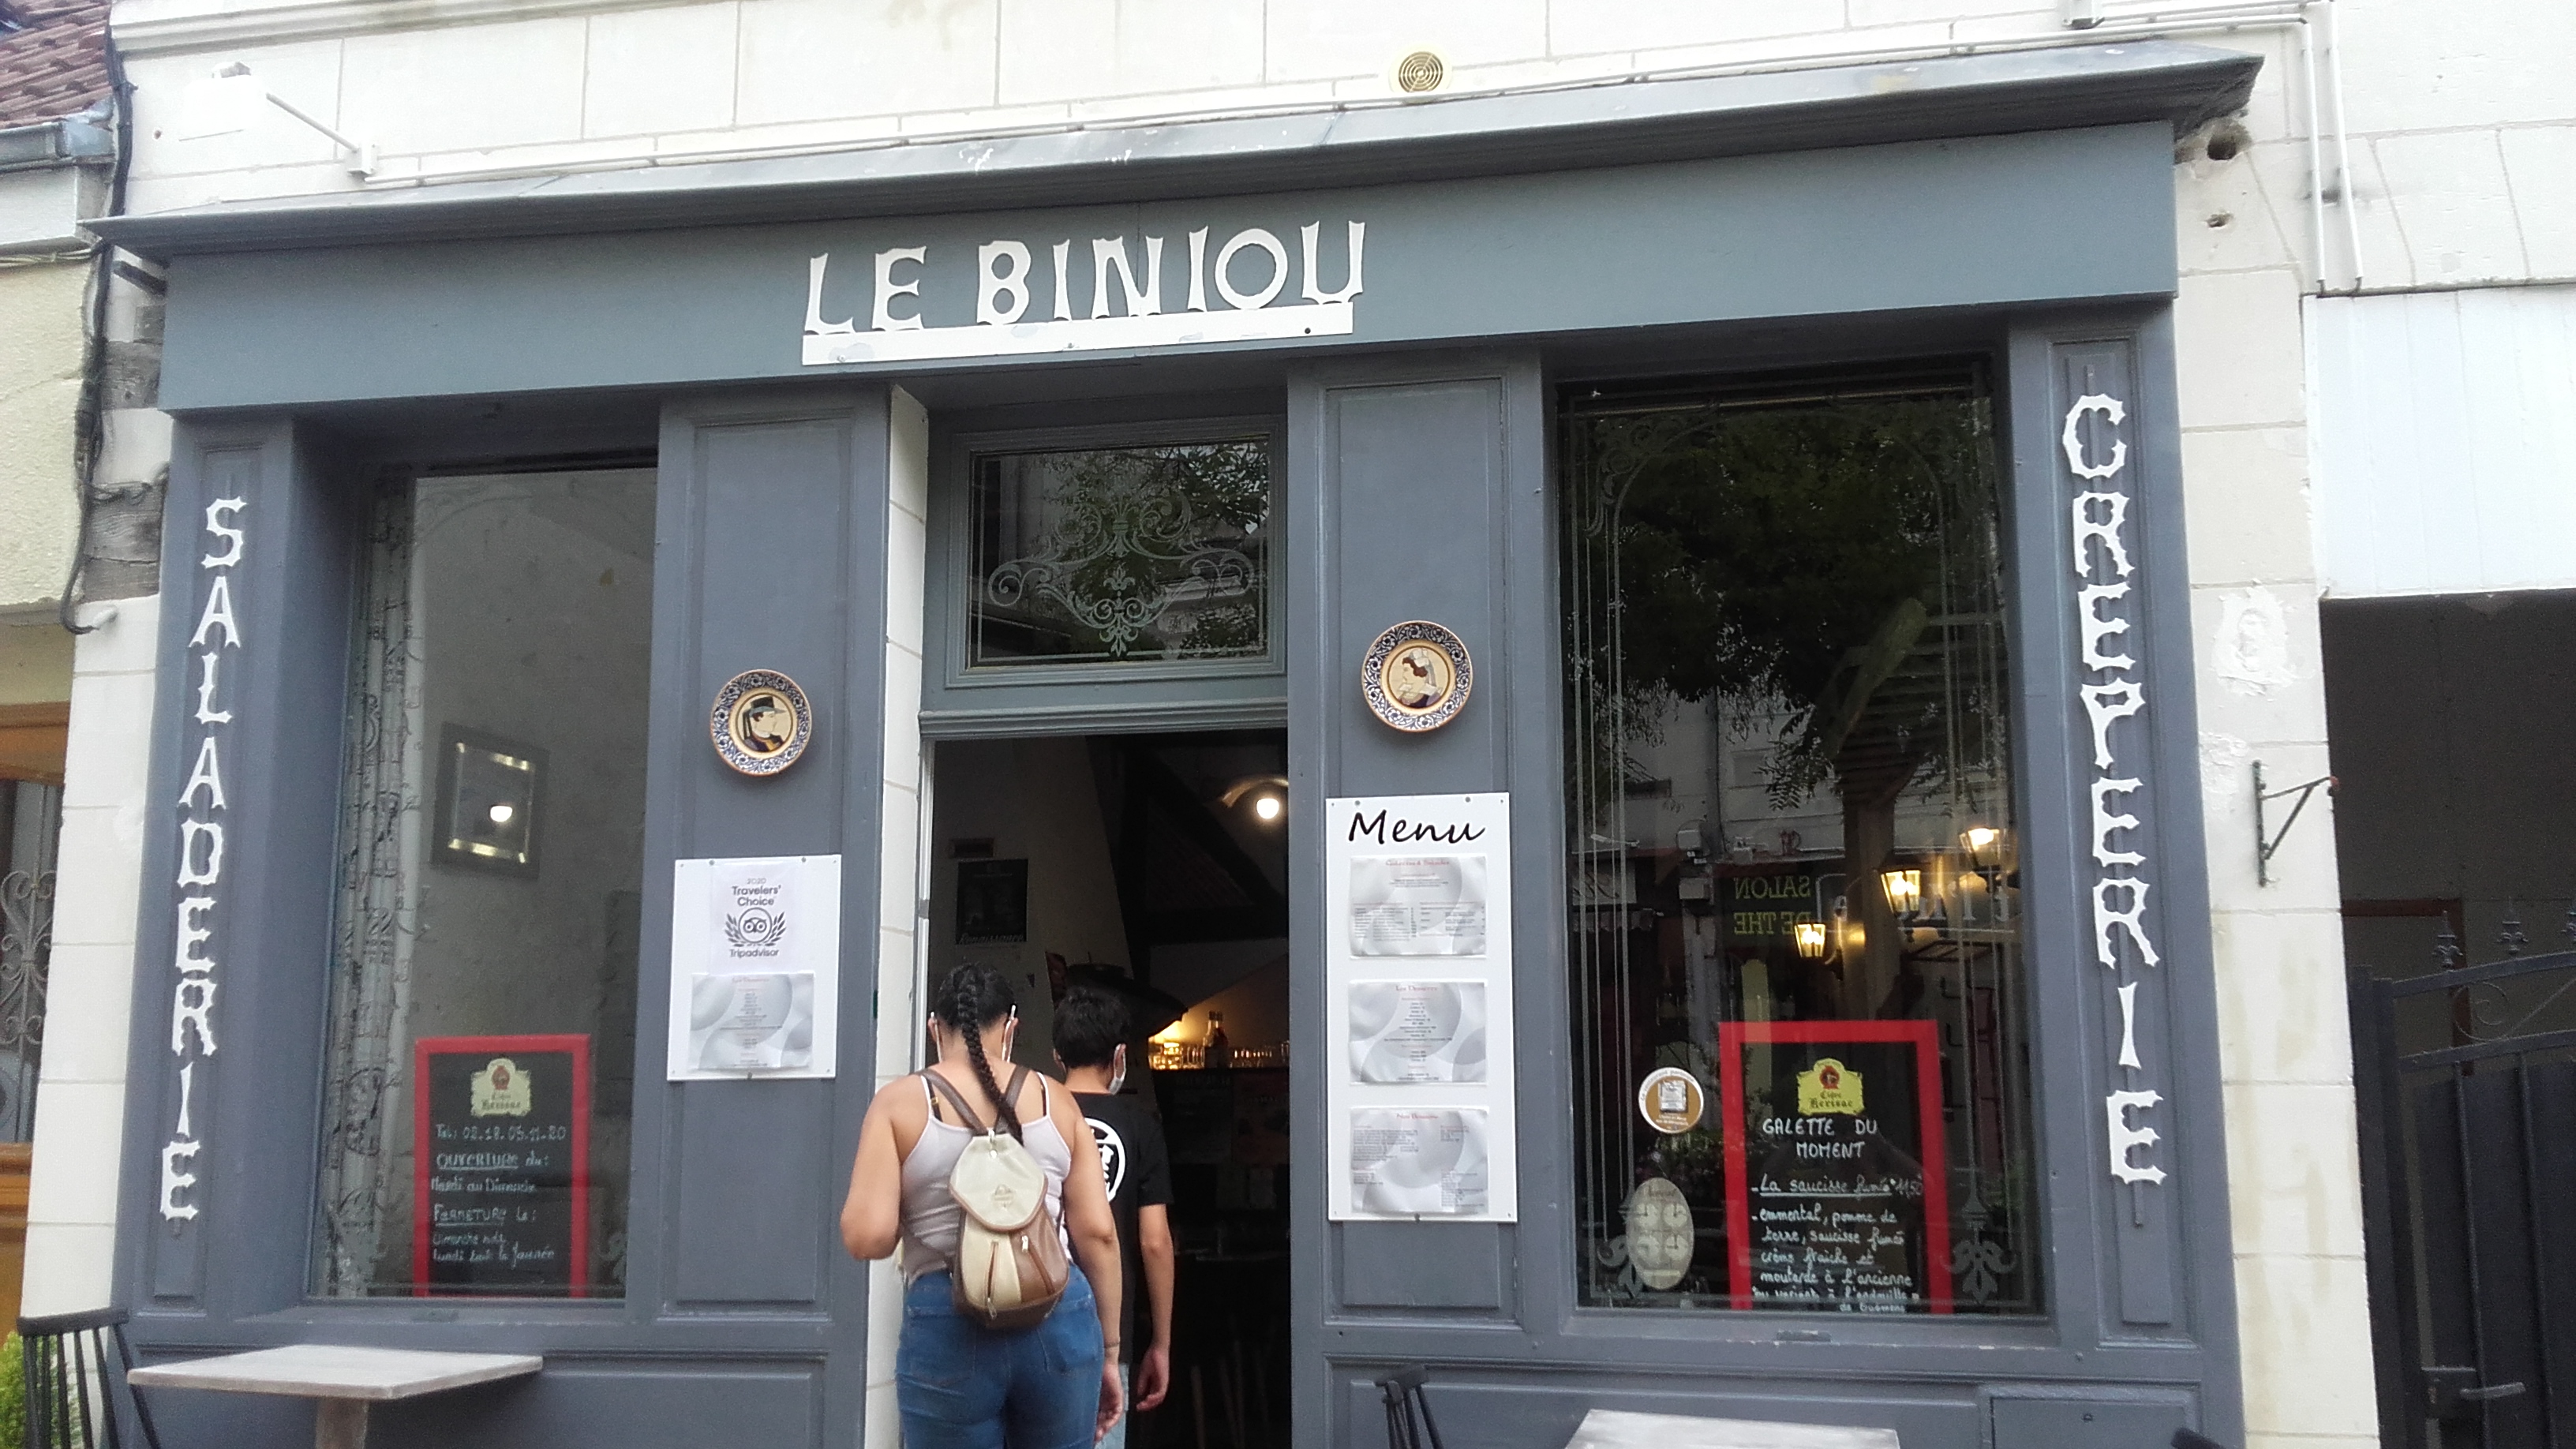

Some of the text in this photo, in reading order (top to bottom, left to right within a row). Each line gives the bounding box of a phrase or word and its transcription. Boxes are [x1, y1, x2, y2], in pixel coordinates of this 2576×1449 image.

[803, 220, 1365, 335] LE BINIOU
[2062, 393, 2167, 1185] CREPERIE
[1348, 809, 1485, 845] Menu
[160, 496, 247, 1221] SALADERIE
[732, 885, 782, 896] Travelers'
[737, 897, 775, 907] Choice
[729, 947, 780, 959] Tripadvisor
[1762, 1117, 1878, 1136] GALETTE DU
[1796, 1141, 1866, 1159] MOMENT
